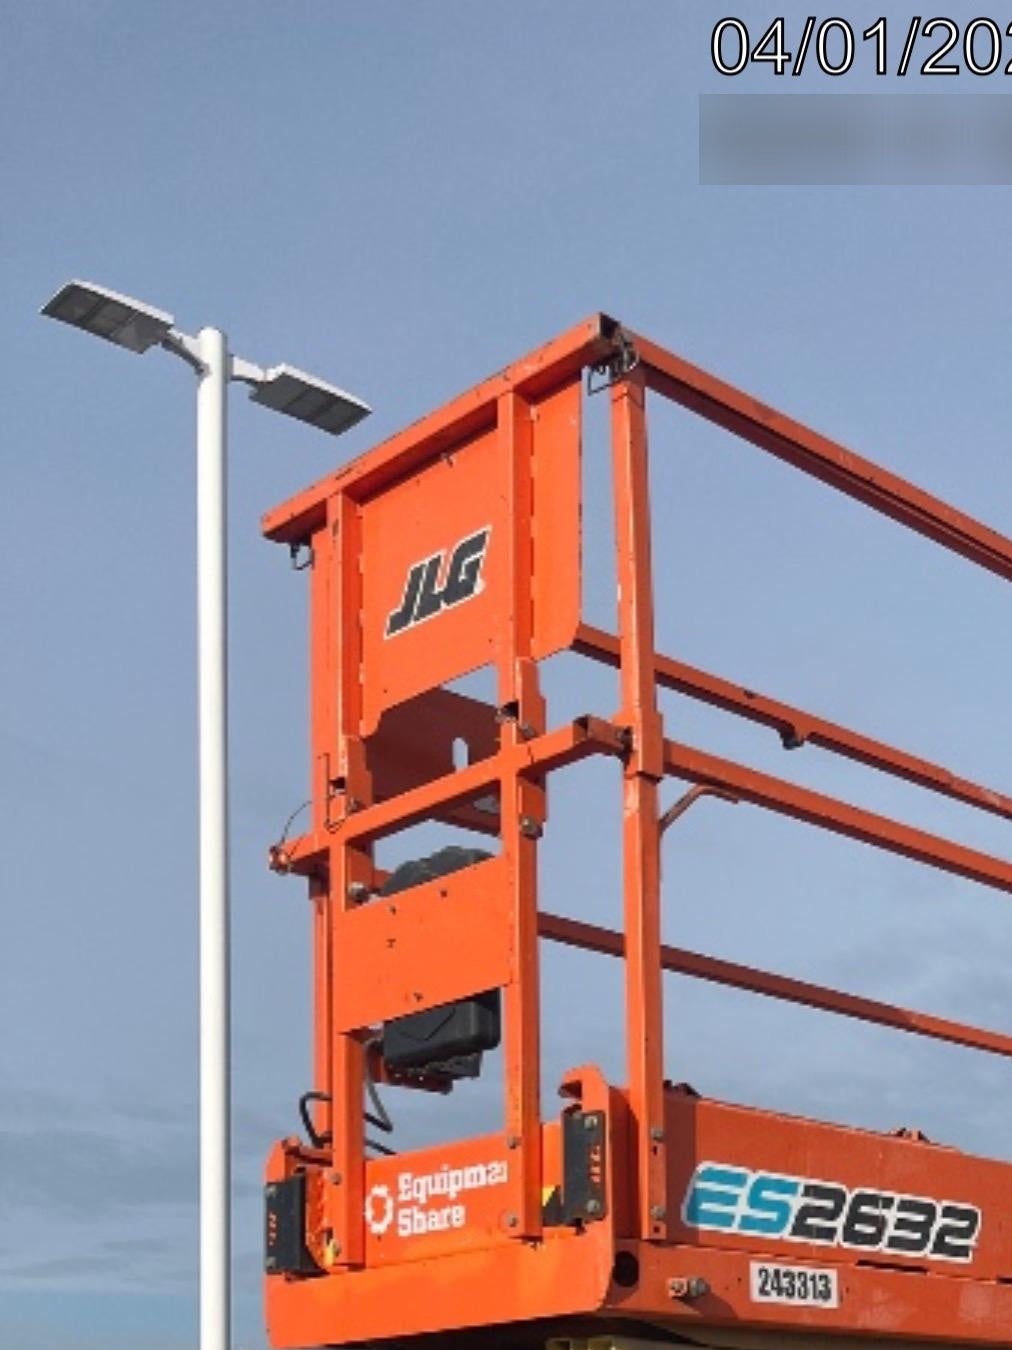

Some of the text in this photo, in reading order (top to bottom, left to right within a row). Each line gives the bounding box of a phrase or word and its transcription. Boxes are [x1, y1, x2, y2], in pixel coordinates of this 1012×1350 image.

[384, 525, 492, 640] JLG
[397, 1204, 466, 1237] Share
[681, 1160, 982, 1264] ES2632
[757, 1266, 832, 1302] 243313
